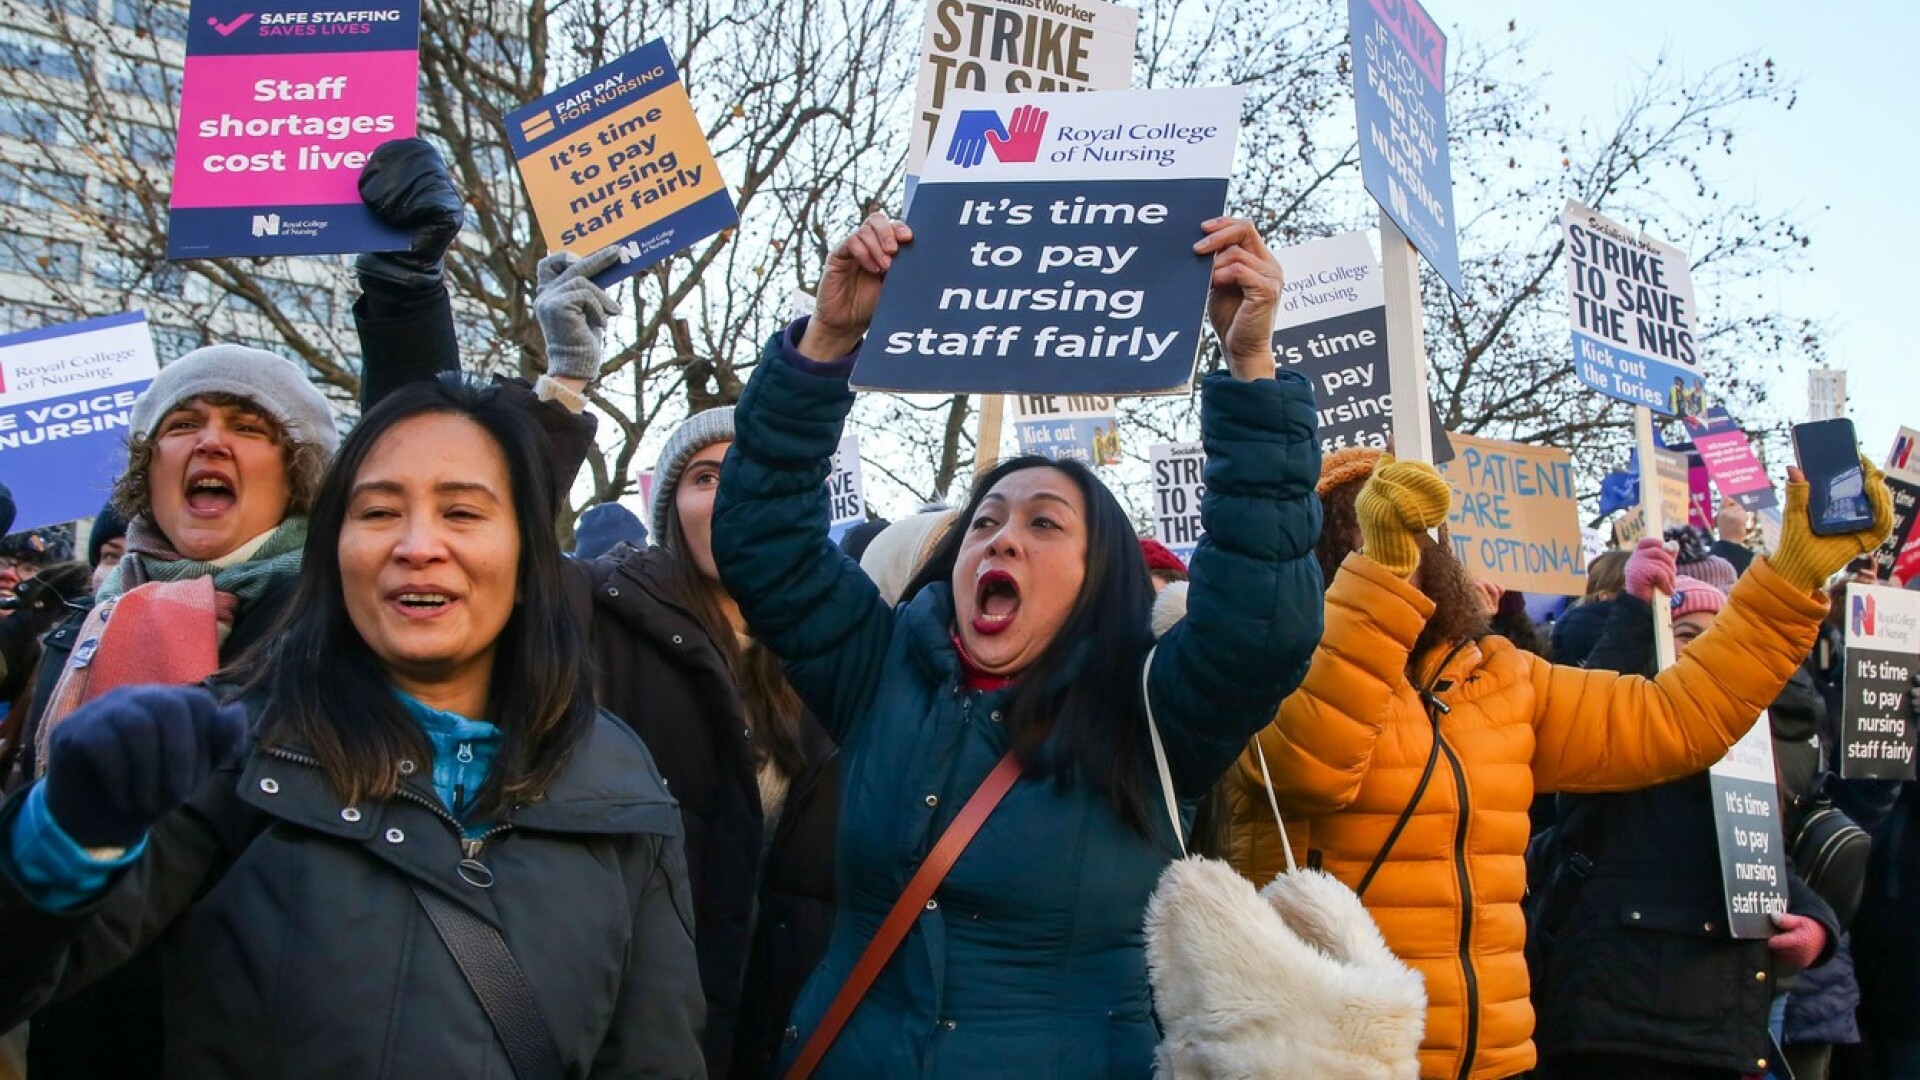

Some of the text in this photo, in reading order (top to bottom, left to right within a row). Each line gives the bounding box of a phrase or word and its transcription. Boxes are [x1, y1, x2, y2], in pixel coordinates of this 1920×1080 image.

[260, 9, 400, 25] SAFE STAFFING
[1043, 0, 1095, 23] Worker
[259, 23, 371, 37] SAVES LIVES
[933, 0, 1094, 82] STRIKE
[1375, 19, 1388, 47] IF
[1392, 39, 1424, 97] YOU
[254, 76, 347, 102] Staff
[556, 72, 624, 115] FAIR PAY
[559, 66, 665, 125] FOR NURSING
[1365, 34, 1437, 138] SUPPORT
[199, 114, 394, 140] shortages
[1366, 62, 1438, 166] FAIR PAY
[550, 107, 662, 171] It's time
[1057, 122, 1218, 146] Royal College
[1389, 116, 1424, 177] FOR
[203, 144, 373, 172] cost live
[570, 134, 657, 186] to pay
[1050, 146, 1176, 167] of Nursing
[569, 151, 678, 215] nursing
[1371, 120, 1445, 229] NURSING
[560, 164, 702, 246] staff fairly
[959, 196, 1169, 225] It's time
[970, 242, 1139, 274] to pay
[1569, 224, 1668, 290] STRIKE
[1317, 263, 1369, 284] College
[939, 280, 1145, 319] nursing
[1284, 286, 1358, 312] of Nursing
[1571, 257, 1688, 329] TO SAVE
[884, 326, 1179, 362] staff fairly
[1307, 328, 1377, 358] time
[1573, 292, 1697, 366] THE NHS
[15, 348, 136, 379] Royal College
[1581, 339, 1648, 380] Kick out
[17, 366, 113, 392] of Nursing
[1321, 362, 1374, 396] pay
[1583, 361, 1663, 407] the Tories
[25, 390, 136, 424] VOICE
[0, 410, 131, 452] NURSIN
[1023, 424, 1076, 444] Kick out
[832, 471, 855, 495] VE
[1155, 457, 1204, 487] STRI
[1463, 447, 1572, 499] PATIENT
[1157, 487, 1186, 515] TO
[1160, 515, 1200, 544] THE
[1480, 536, 1586, 576] OPTIONAL
[1857, 660, 1909, 682] It's time
[1862, 688, 1902, 710] to pay
[1857, 714, 1906, 737] nursing
[1848, 740, 1913, 764] staff fairly
[1725, 791, 1770, 817] It's time
[1734, 826, 1769, 854] to pay
[1735, 858, 1777, 887] nursing
[1732, 891, 1758, 914] staff
